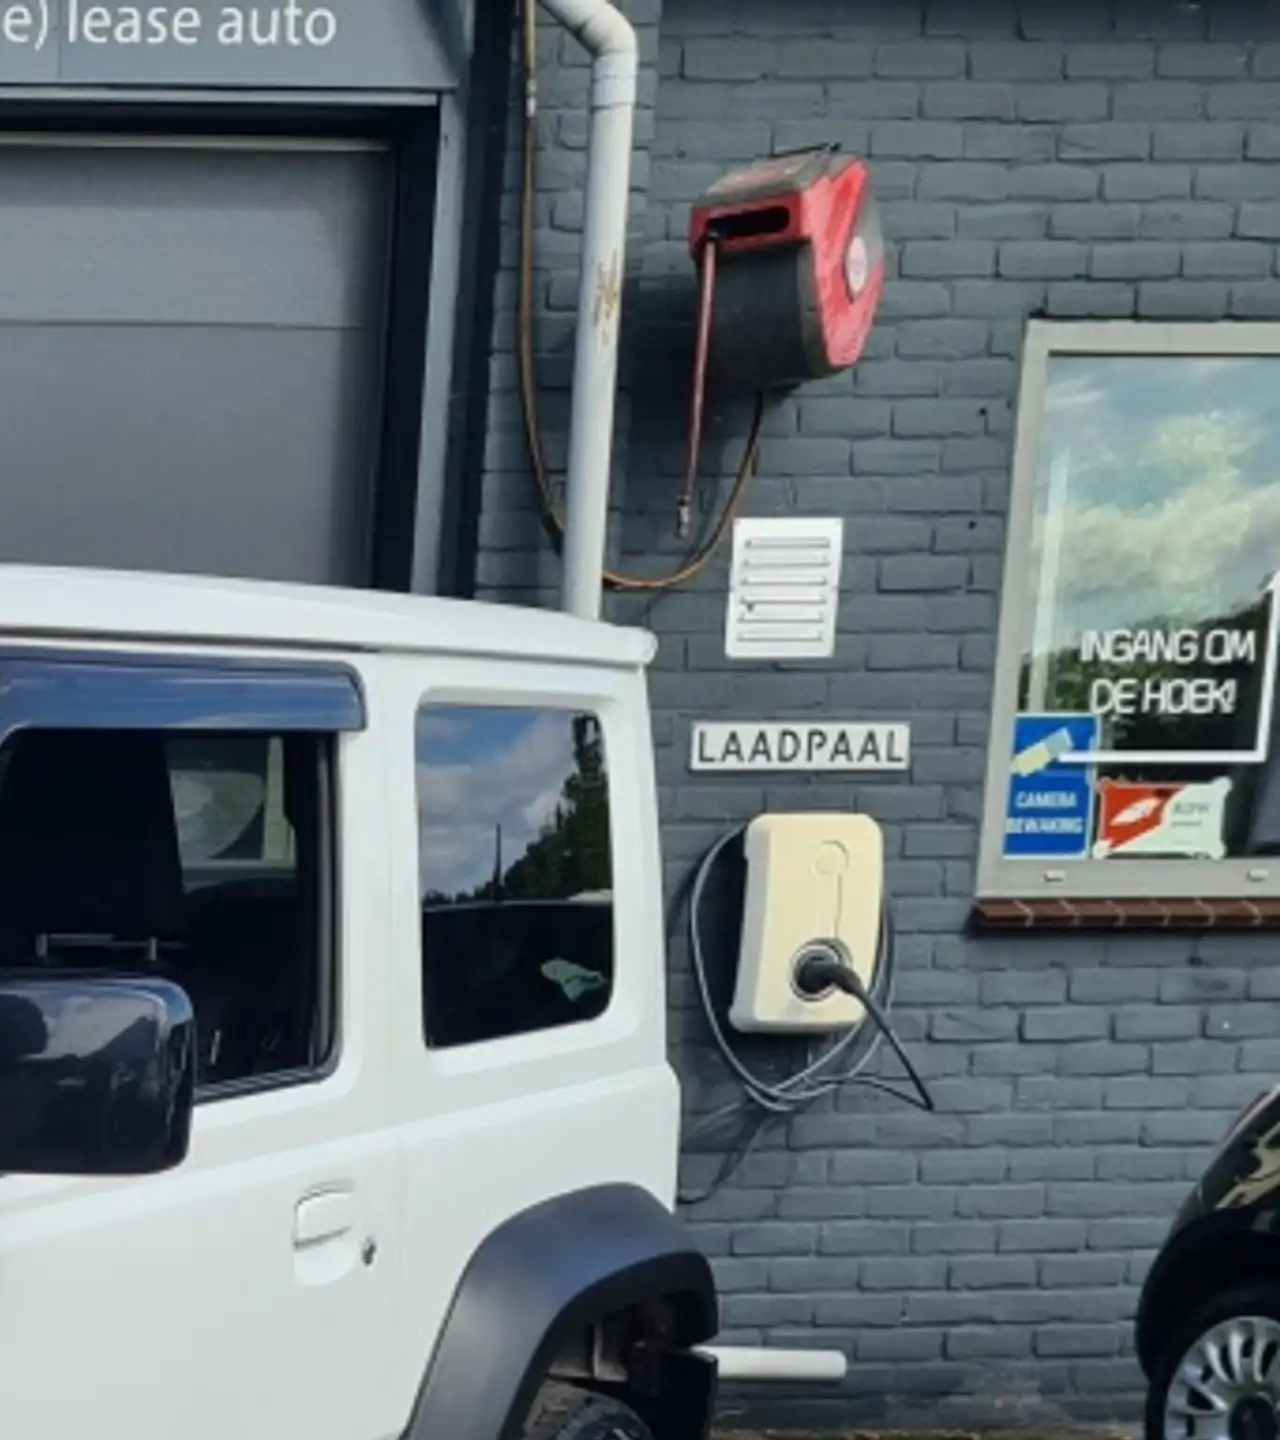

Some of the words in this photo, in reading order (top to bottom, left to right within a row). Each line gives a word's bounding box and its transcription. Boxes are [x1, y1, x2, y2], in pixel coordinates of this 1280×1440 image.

[67, 0, 202, 43] lease
[217, 0, 337, 46] auto
[1080, 629, 1199, 664] INGANG
[1204, 628, 1256, 664] OM
[1091, 678, 1138, 714] DE
[697, 730, 905, 764] LAADPAAL
